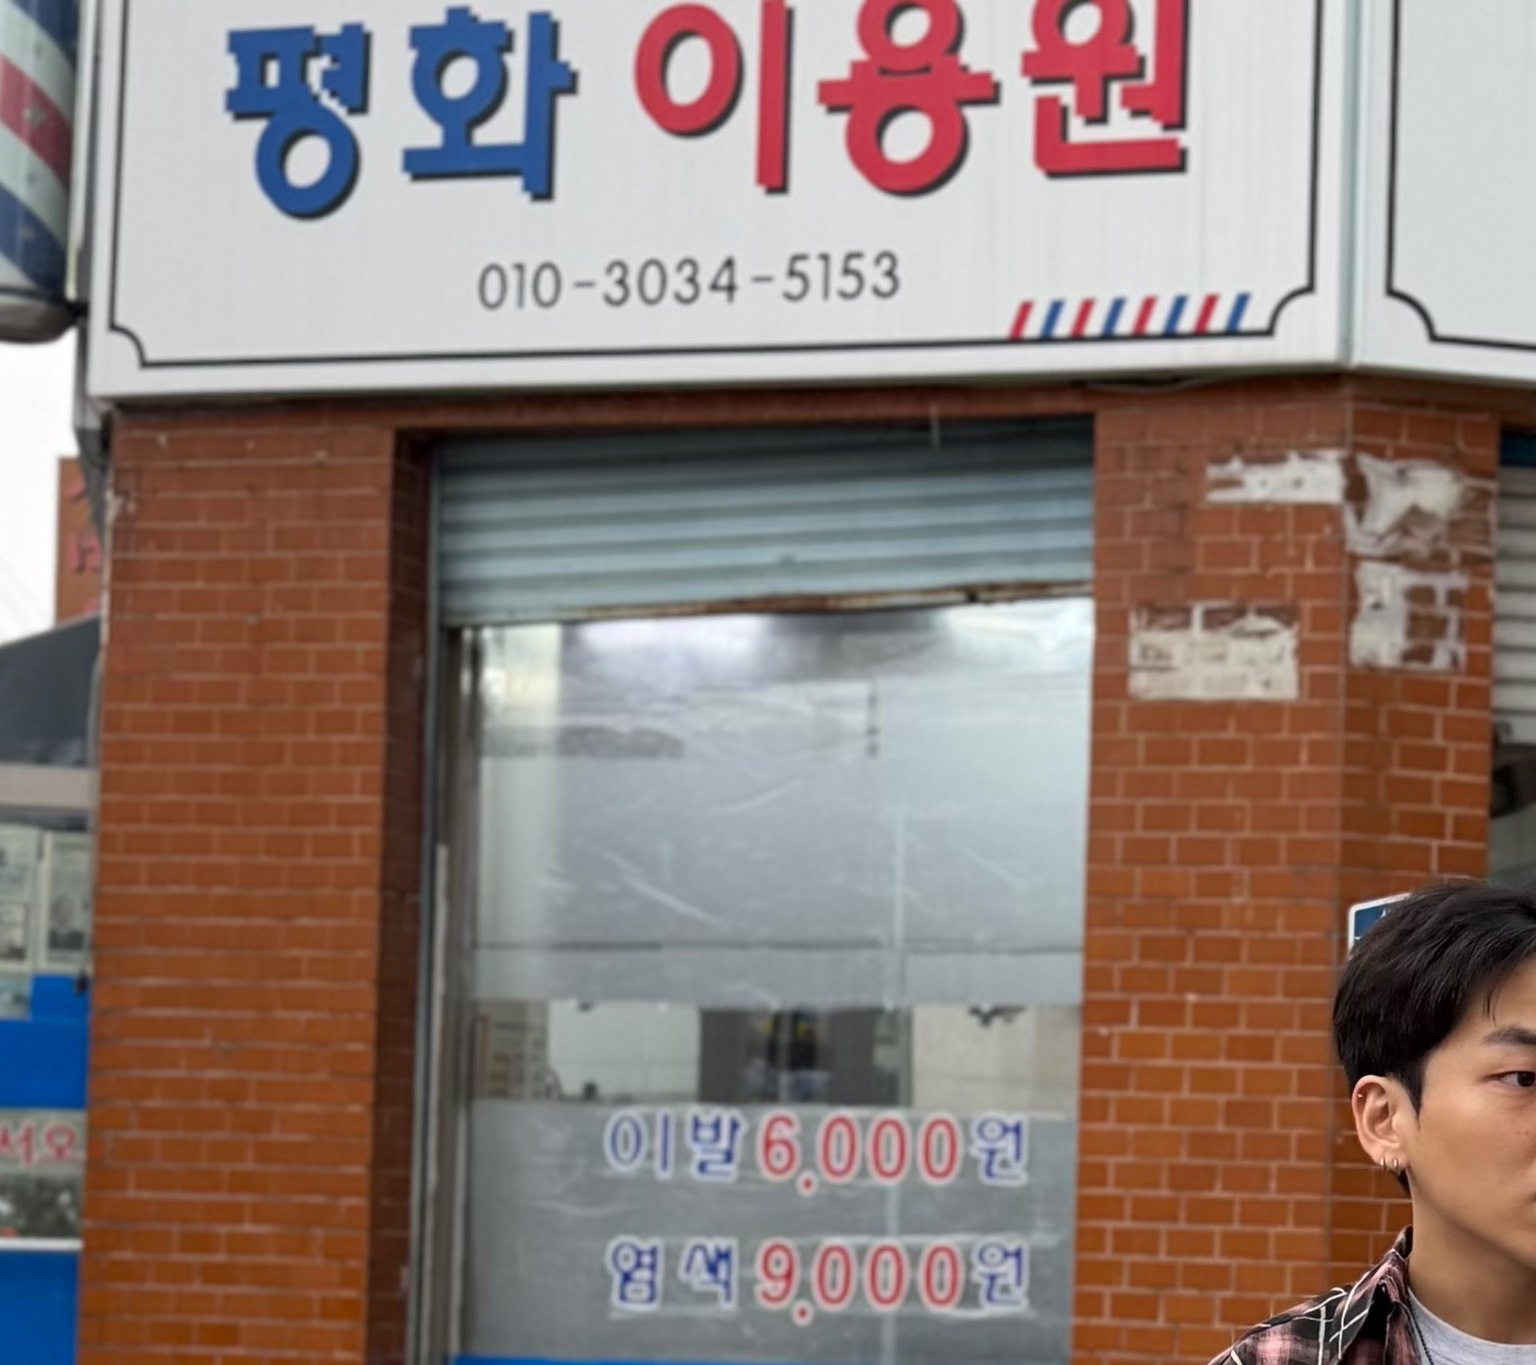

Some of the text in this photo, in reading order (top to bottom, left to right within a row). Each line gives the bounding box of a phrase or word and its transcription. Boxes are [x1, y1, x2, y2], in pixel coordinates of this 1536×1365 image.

[225, 0, 1189, 220] 평화 이용원
[478, 250, 901, 310] 010-3034-5153
[607, 1106, 747, 1181] 이발
[607, 1234, 738, 1311] 염색
